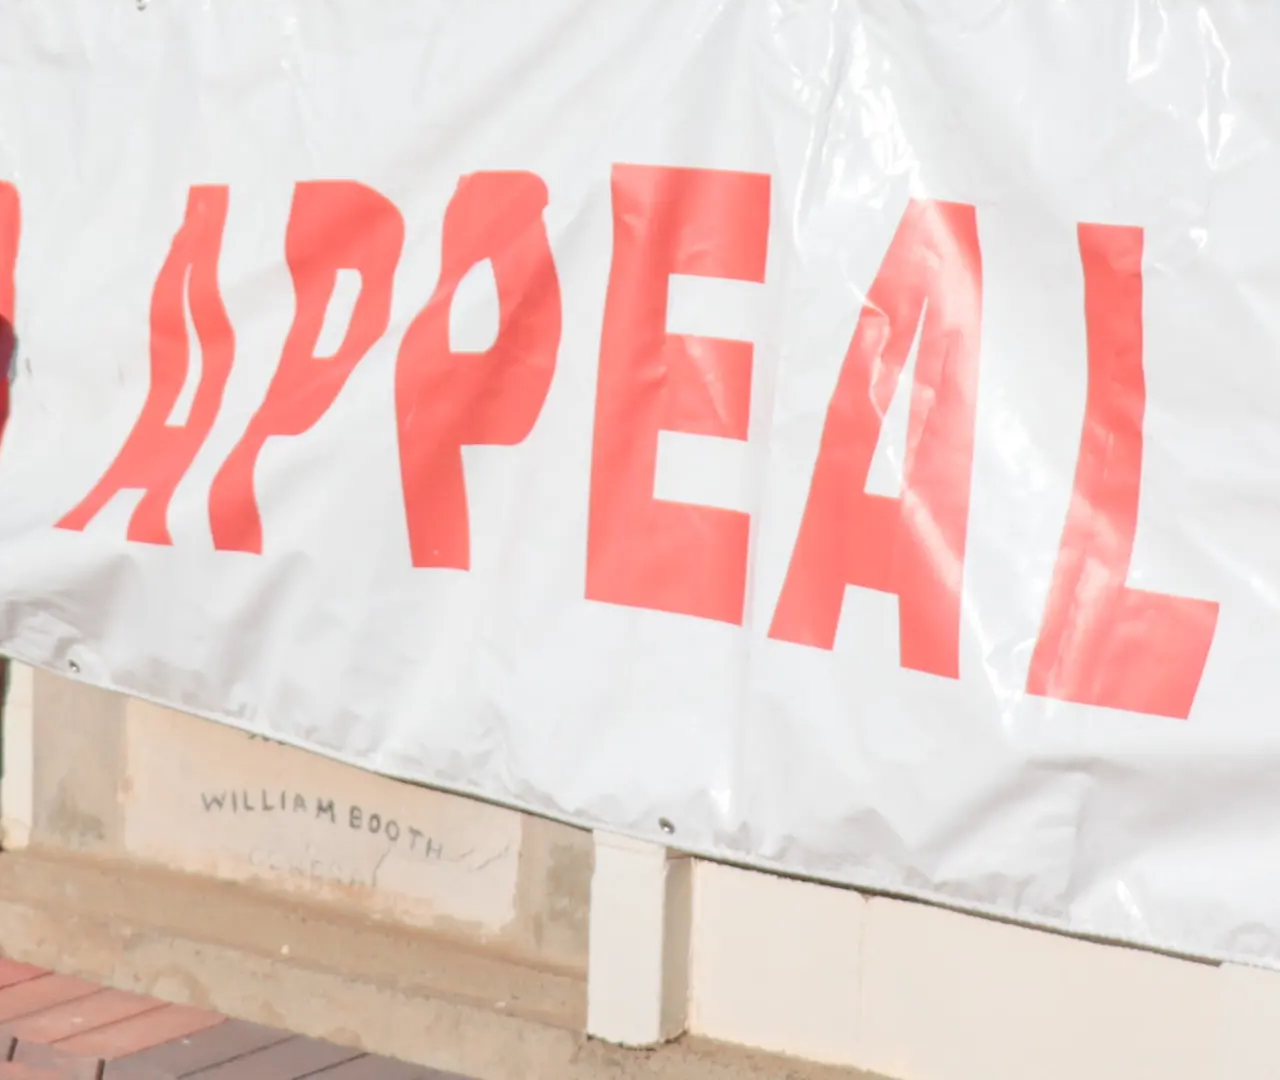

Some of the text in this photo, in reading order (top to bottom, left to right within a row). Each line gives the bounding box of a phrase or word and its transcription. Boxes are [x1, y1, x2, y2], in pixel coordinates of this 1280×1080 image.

[52, 162, 1220, 720] APPEAL
[201, 788, 444, 861] WILLIAM BOOTH
